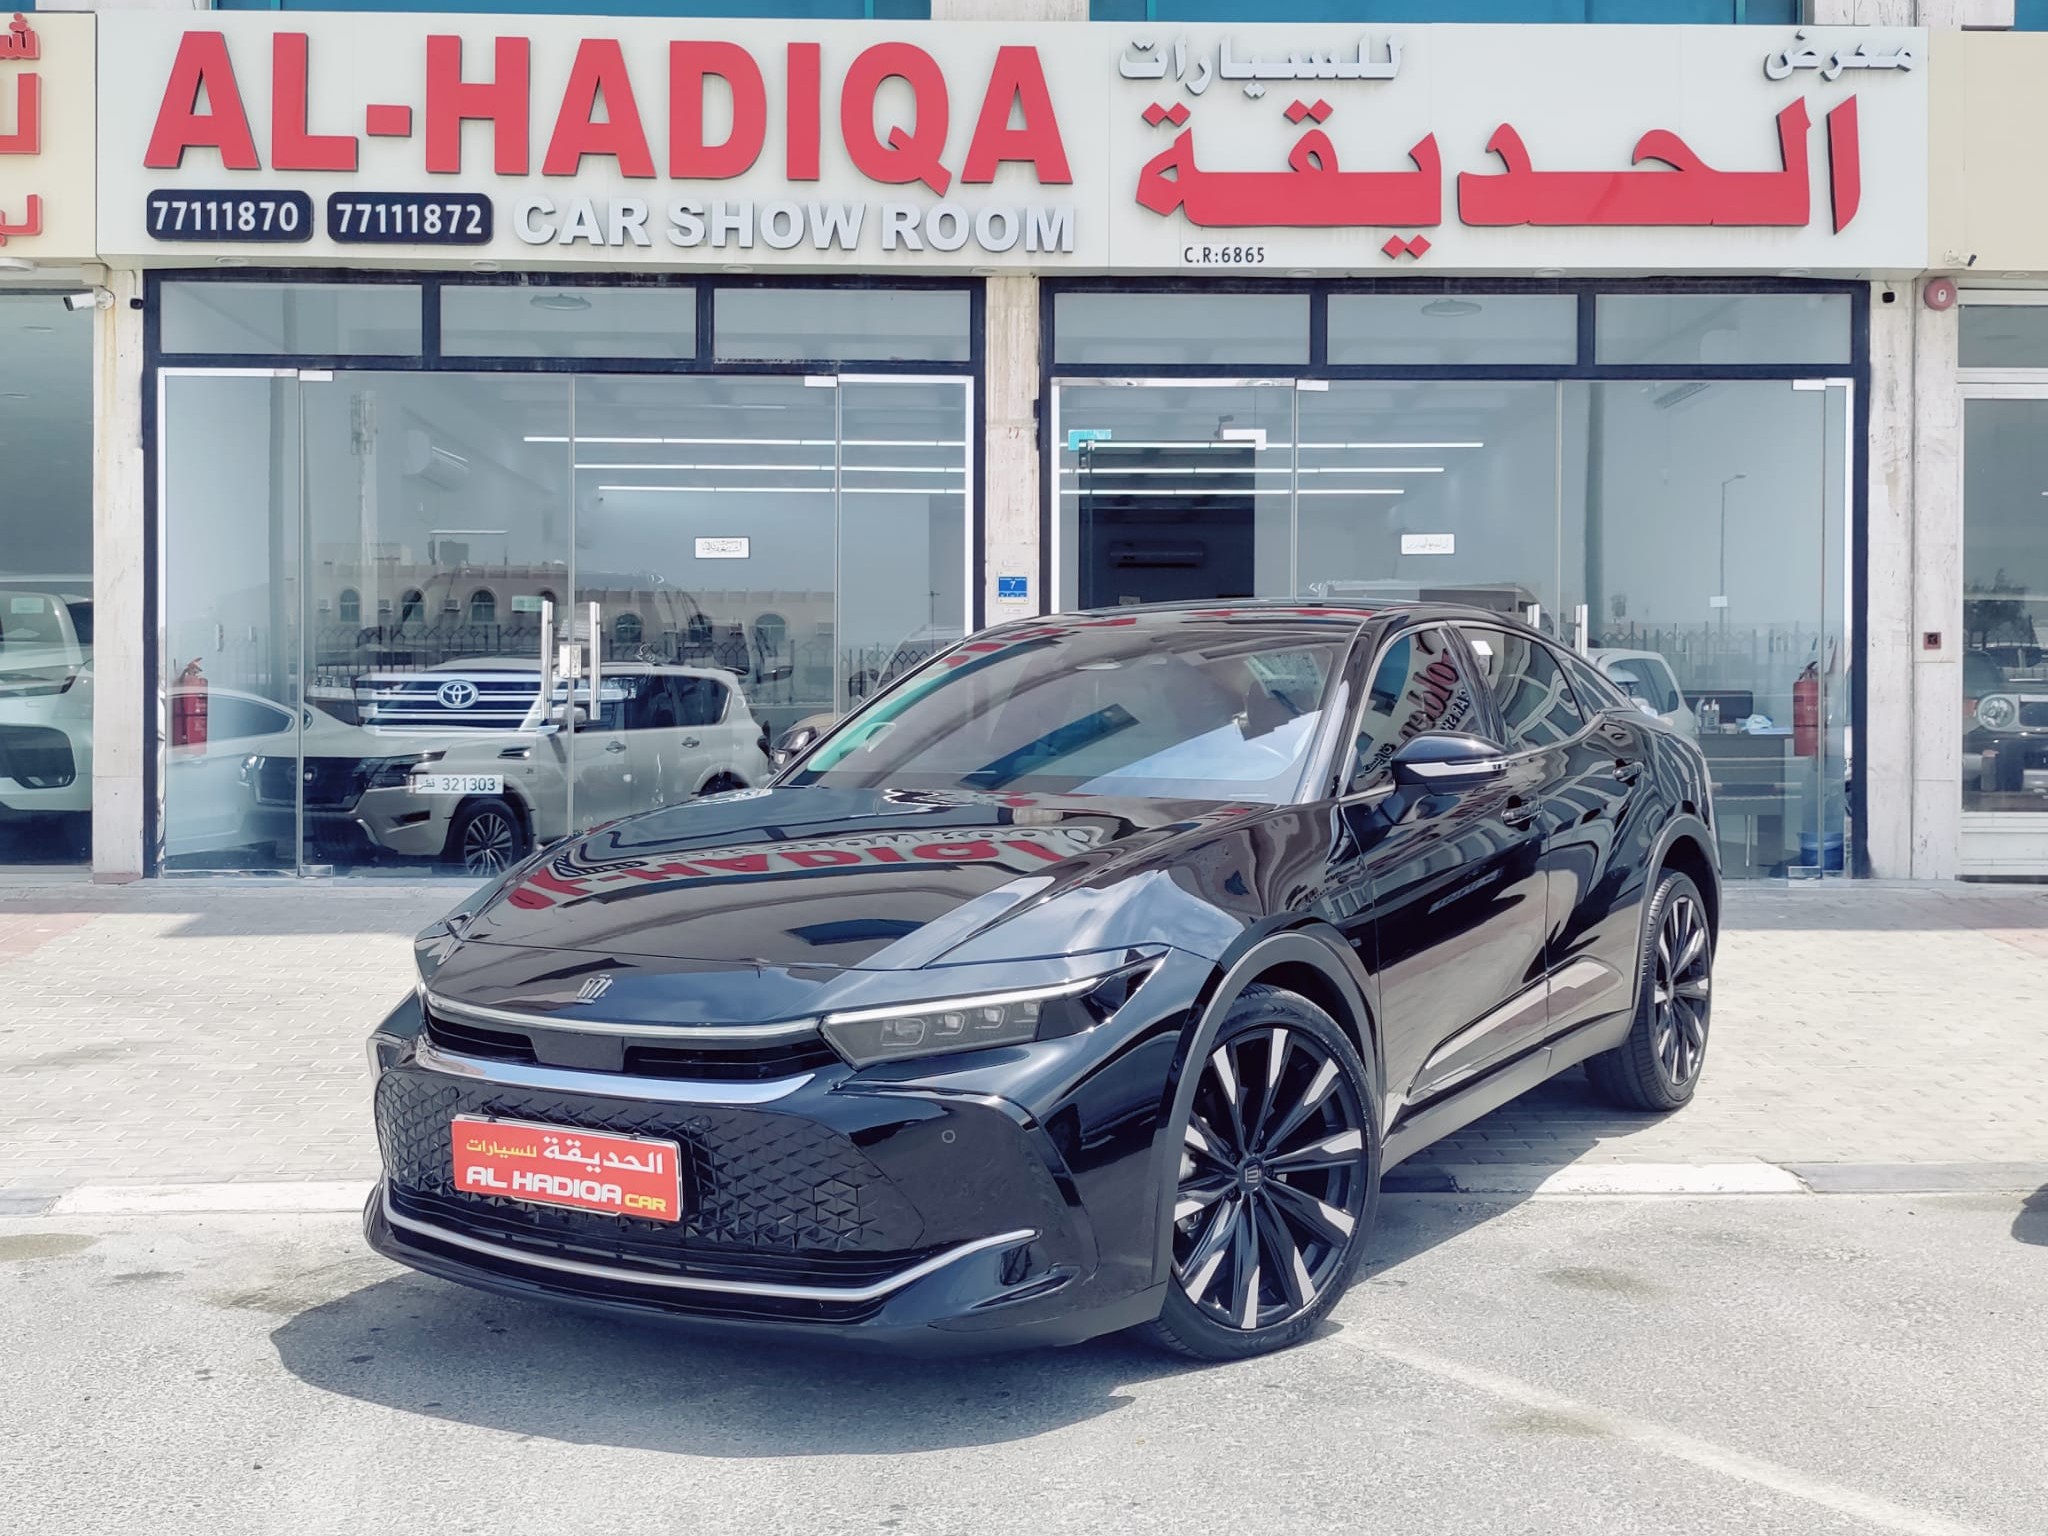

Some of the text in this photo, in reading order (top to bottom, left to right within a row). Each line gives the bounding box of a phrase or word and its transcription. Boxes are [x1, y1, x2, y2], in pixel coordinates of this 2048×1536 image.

[1119, 34, 1403, 99] للسيارات
[1764, 30, 1913, 82] معرض
[143, 31, 1073, 197] AL-HADIQA
[1136, 94, 1861, 259] الحديقة
[152, 200, 299, 233] 77111870
[336, 203, 482, 236] 77111872
[514, 197, 1075, 253] CAR SHOW ROOM
[442, 778, 496, 791] 321303
[466, 1136, 663, 1174] الحديقة للسيارات
[466, 1166, 667, 1212] AL HADIQA CAR
